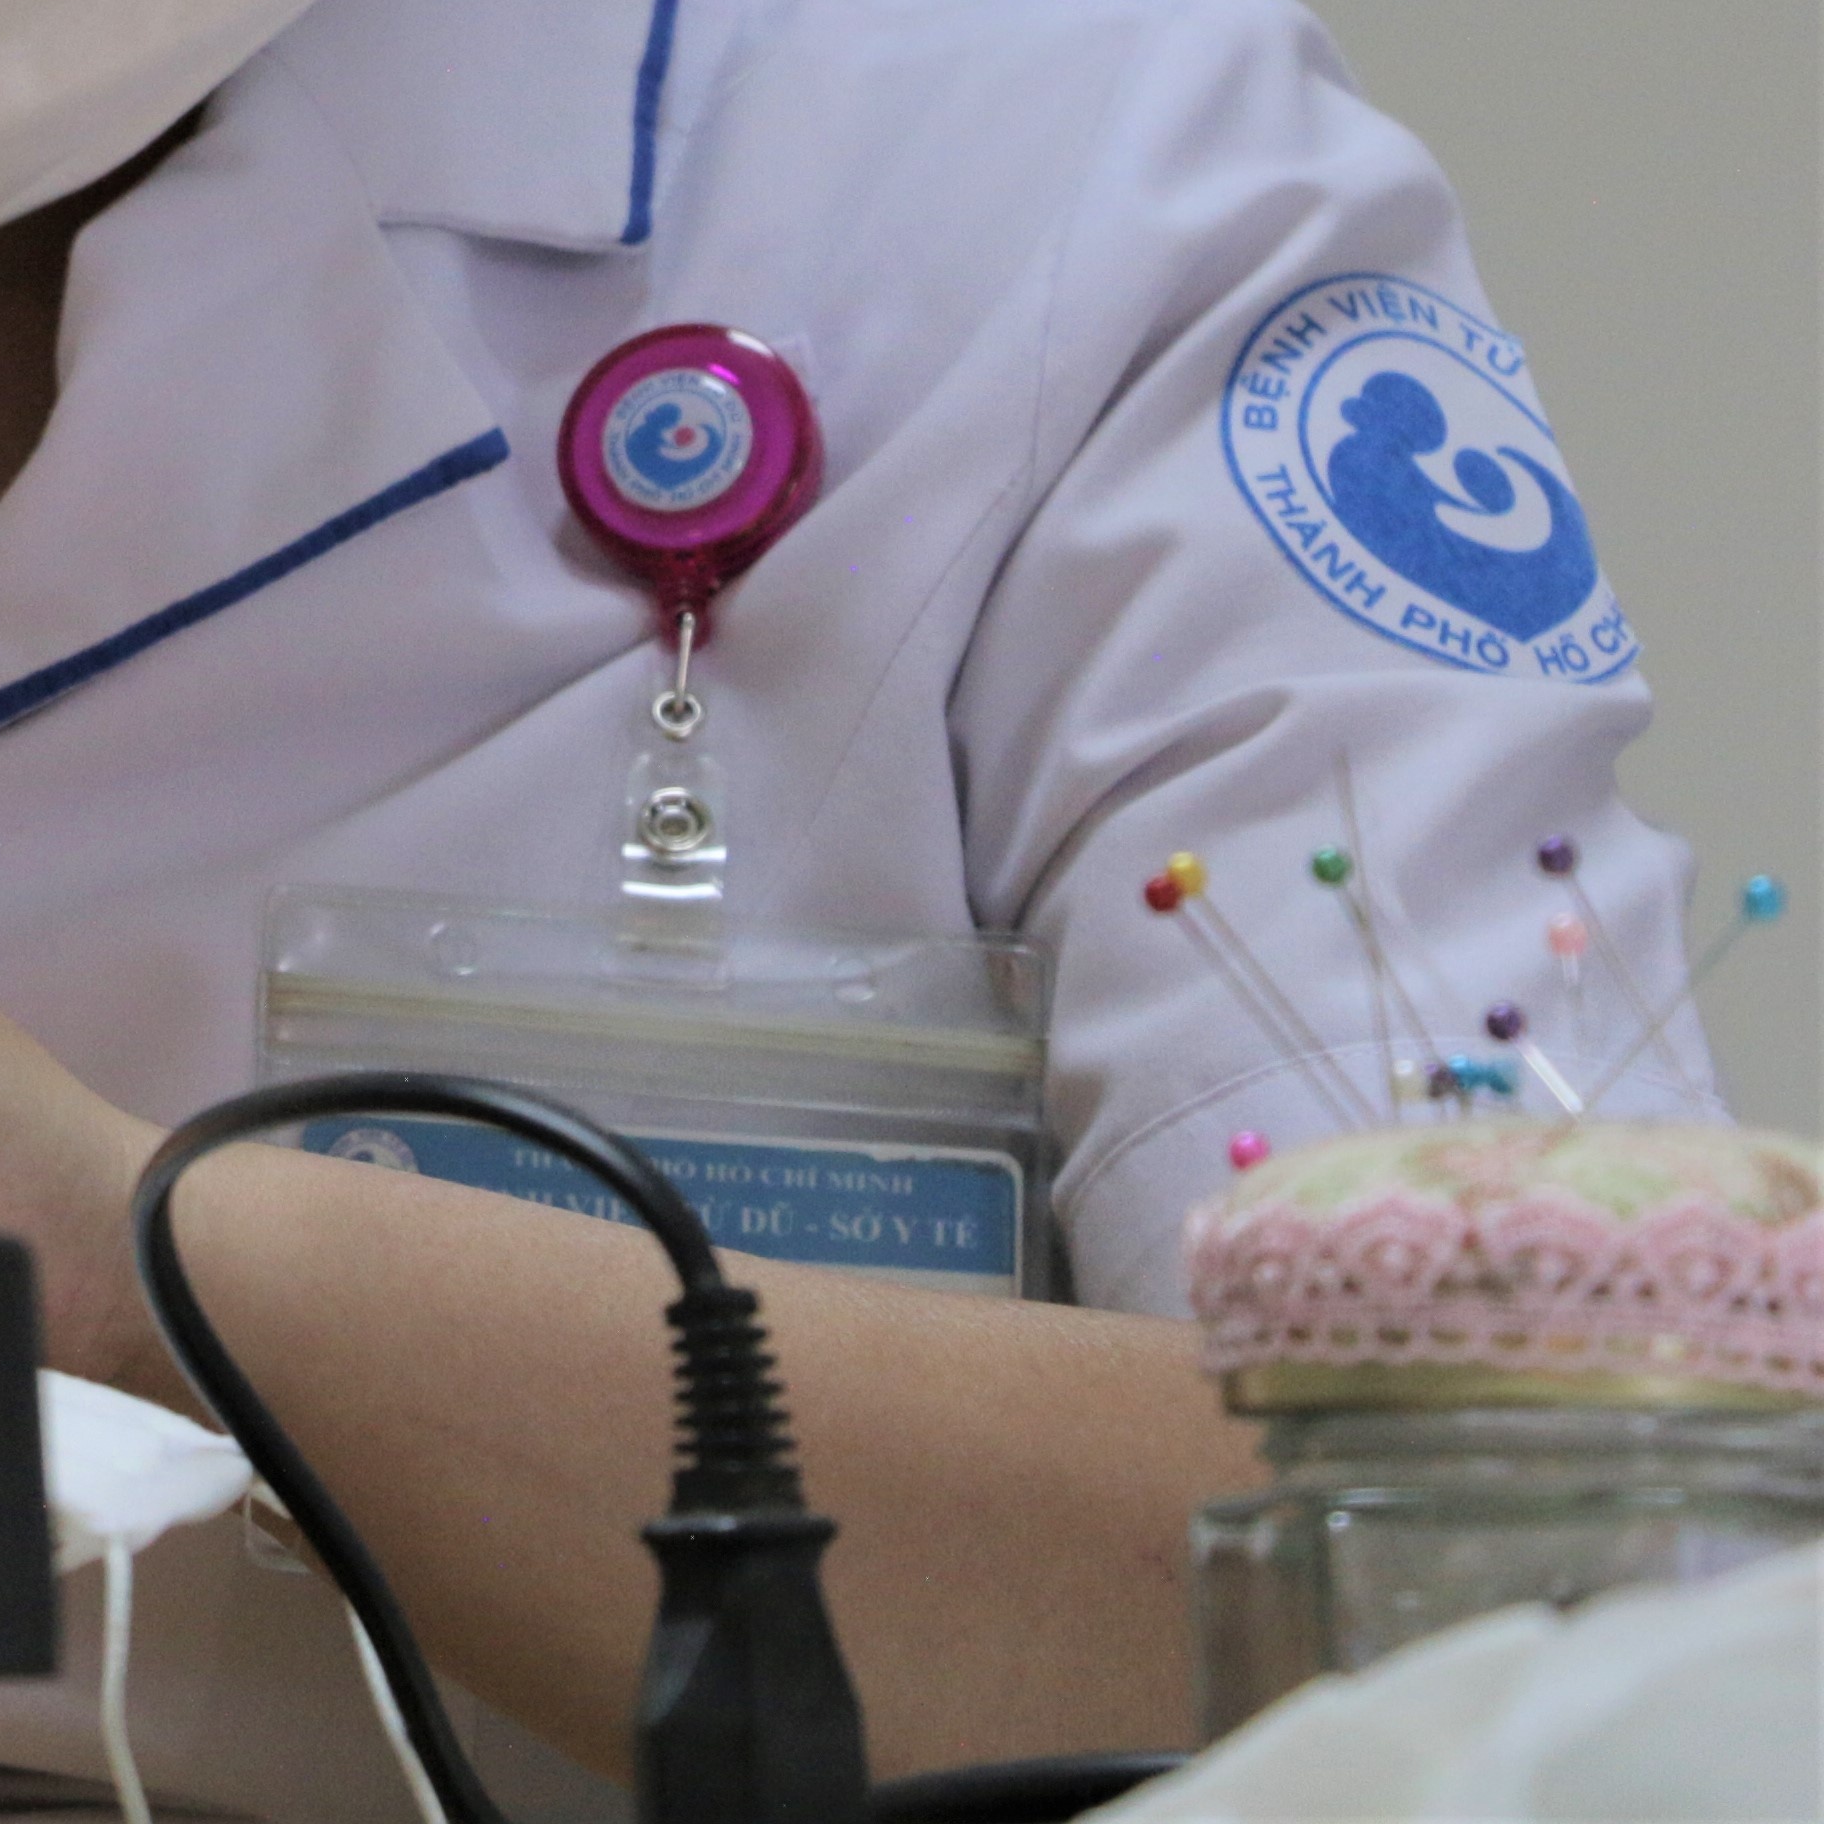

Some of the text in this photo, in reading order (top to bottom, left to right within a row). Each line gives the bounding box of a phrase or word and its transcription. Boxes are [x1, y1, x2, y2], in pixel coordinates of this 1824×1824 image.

[1244, 312, 1327, 431] BỆNH
[1329, 283, 1438, 329] VIỆN
[1257, 466, 1387, 609] THÀNH
[1400, 602, 1510, 669] PHỐ
[1533, 632, 1591, 676] HỒ
[739, 1199, 796, 1237] DŨ
[892, 1216, 918, 1245] Y
[760, 1165, 819, 1189] CHÍ
[826, 1170, 914, 1196] MINH
